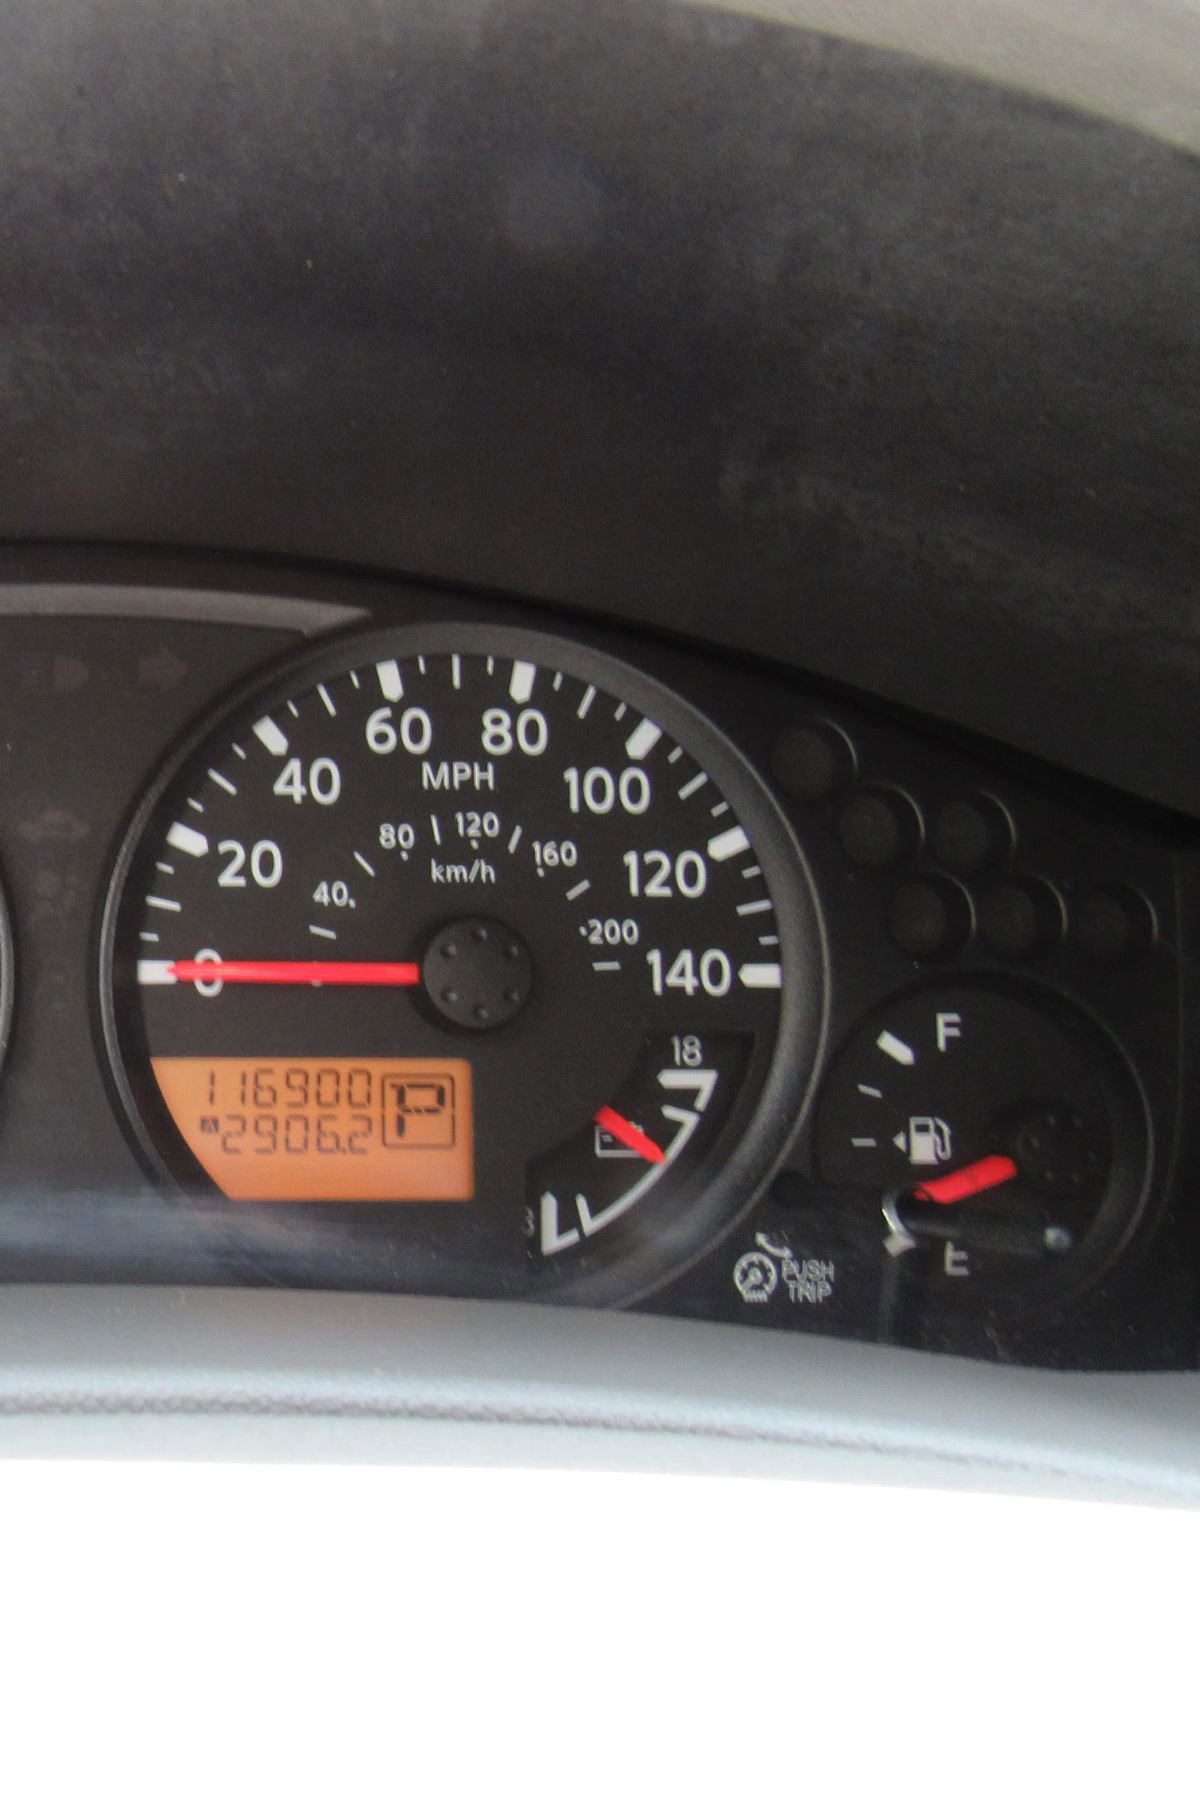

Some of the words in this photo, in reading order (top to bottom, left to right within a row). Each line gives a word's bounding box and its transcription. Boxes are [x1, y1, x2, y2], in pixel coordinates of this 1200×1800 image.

[365, 706, 433, 754] 60
[481, 706, 548, 756] 80
[273, 757, 341, 805] 40
[421, 761, 494, 790] MPH
[563, 766, 651, 814] 100
[379, 823, 415, 850] 80
[455, 811, 500, 837] 120
[217, 839, 283, 888] 20
[430, 858, 496, 883] km/h
[532, 840, 578, 867] 160
[623, 848, 708, 898] 120
[312, 880, 347, 907] 40
[588, 918, 639, 945] 200
[193, 948, 224, 997] 0
[646, 948, 732, 997] 140
[671, 1035, 703, 1067] 18
[936, 1012, 961, 1052] F
[208, 1067, 373, 1108] 116900
[390, 1083, 446, 1138] P
[221, 1114, 372, 1154] 2906.2
[781, 1259, 835, 1282] PUSH
[784, 1280, 832, 1303] TRIP
